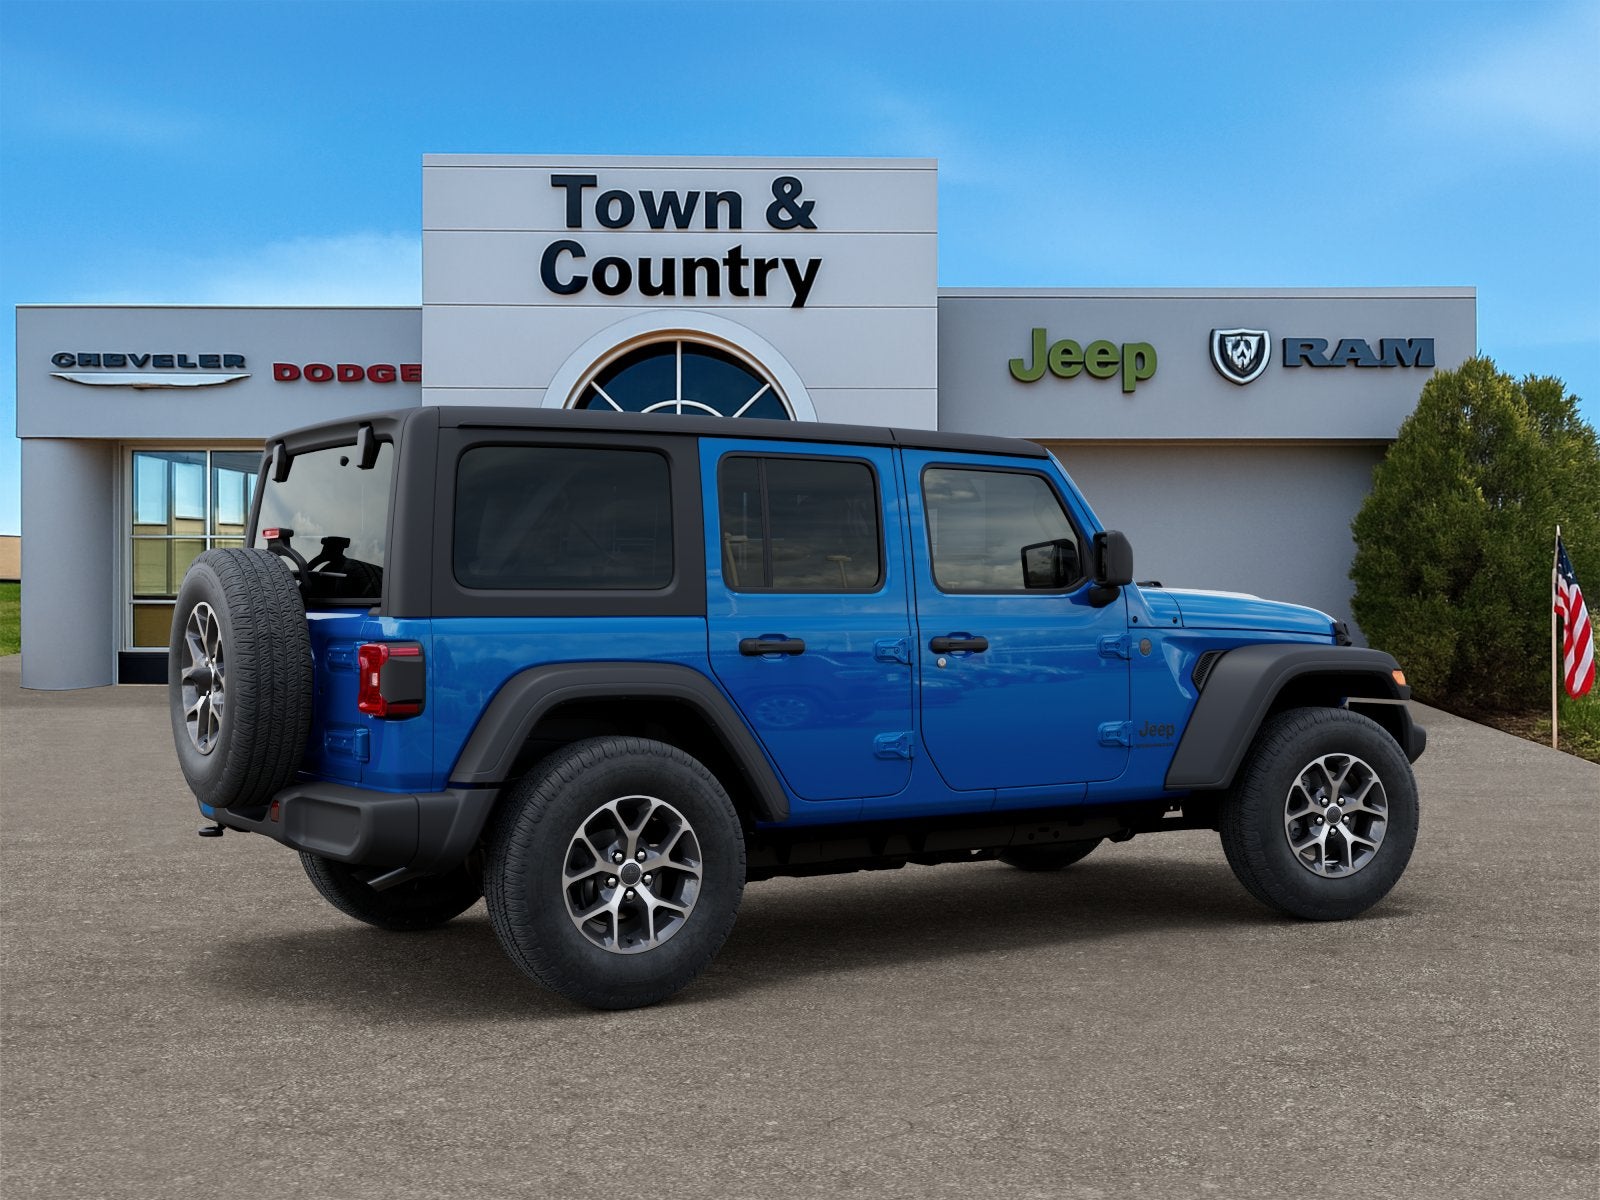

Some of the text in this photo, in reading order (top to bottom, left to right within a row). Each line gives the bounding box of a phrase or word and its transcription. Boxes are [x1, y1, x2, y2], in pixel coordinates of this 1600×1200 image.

[550, 174, 818, 230] Town &
[540, 239, 822, 308] Country
[273, 363, 422, 383] DODGE
[1008, 327, 1158, 393] Jeep
[1281, 337, 1436, 368] RAM
[1139, 720, 1175, 739] Jeep
